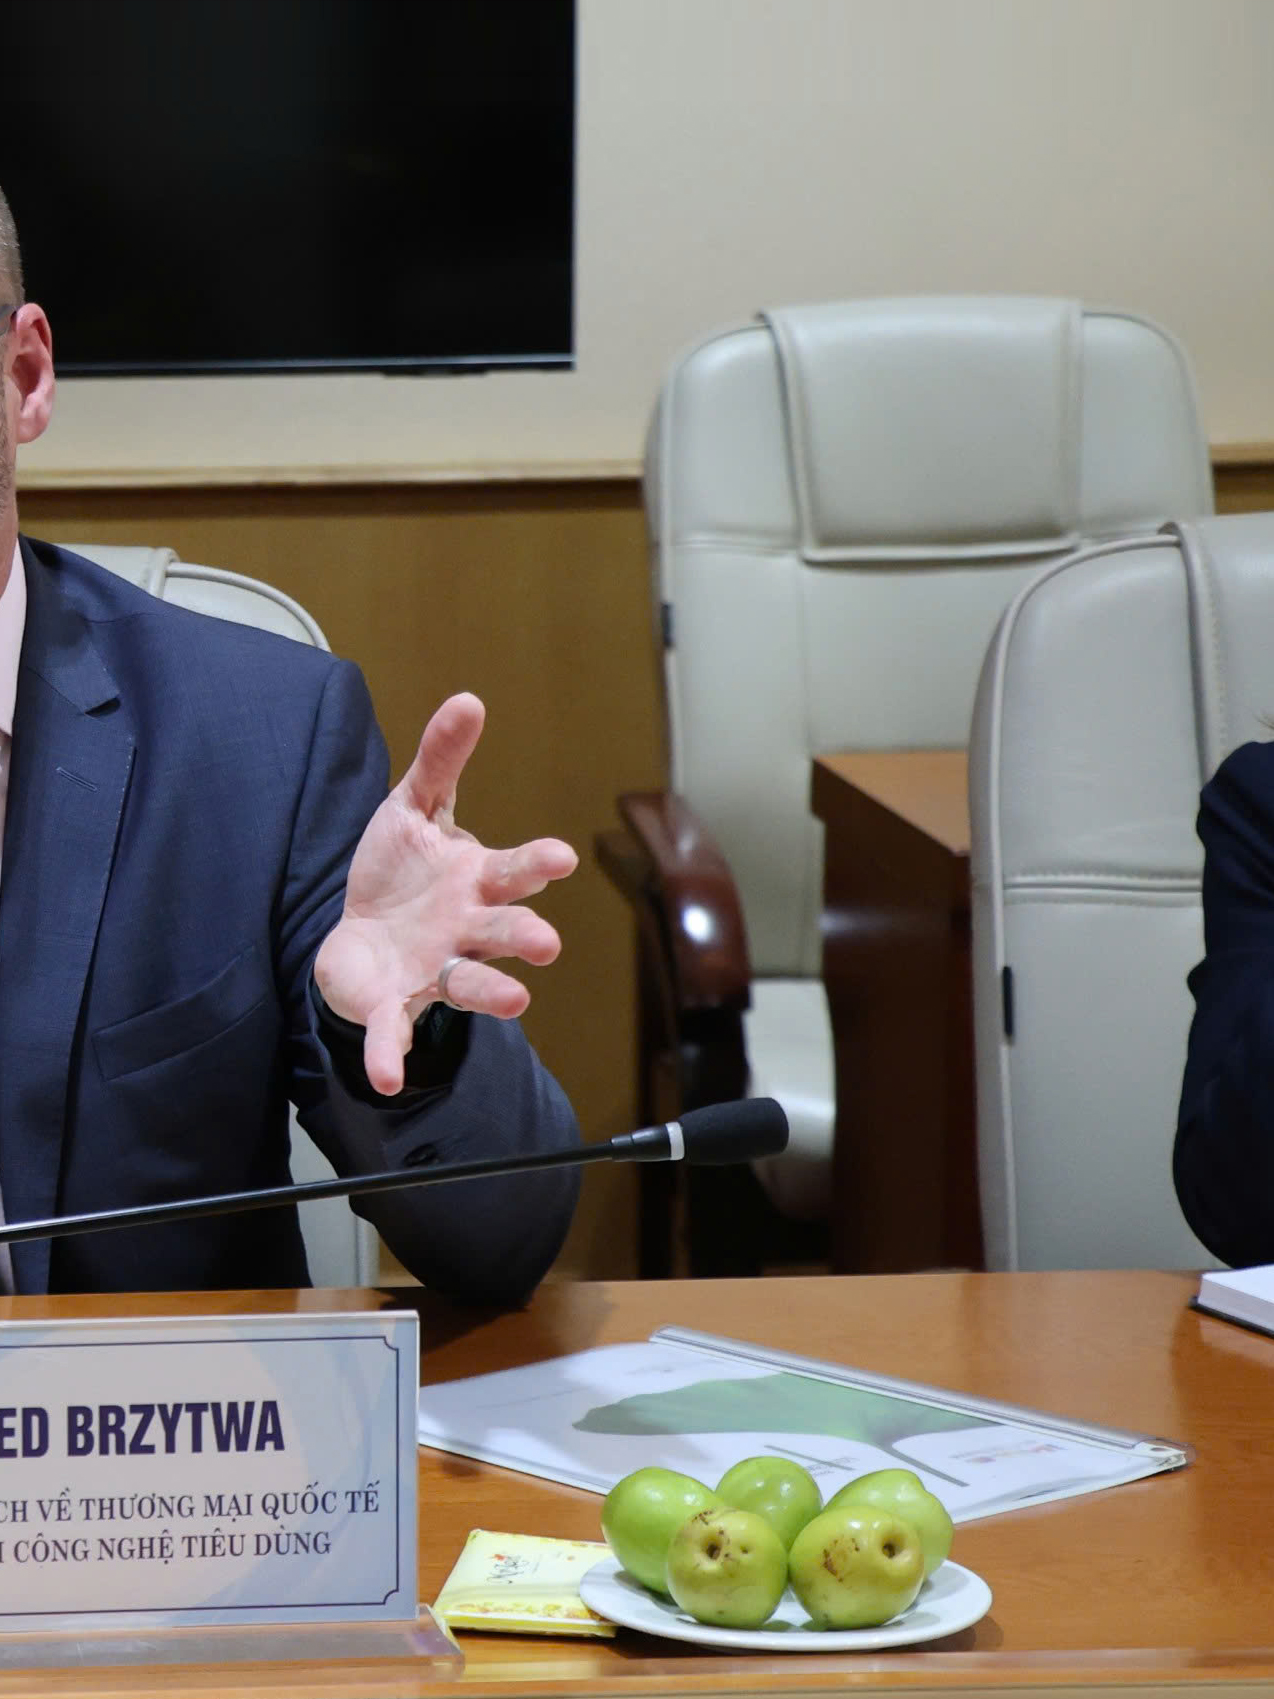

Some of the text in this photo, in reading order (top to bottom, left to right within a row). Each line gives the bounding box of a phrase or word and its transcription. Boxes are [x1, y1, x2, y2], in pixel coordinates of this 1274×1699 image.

[66, 1400, 286, 1458] BRZYTWA
[35, 1487, 72, 1523] VỀ
[79, 1493, 196, 1521] THƯƠNG
[203, 1493, 253, 1523] MẠI
[261, 1481, 337, 1523] QUỐC
[344, 1480, 380, 1515] TẾ
[13, 1532, 90, 1564] CÔNG
[97, 1528, 174, 1565] NGHỆ
[181, 1527, 246, 1558] TIÊU
[253, 1524, 332, 1556] DÙNG
